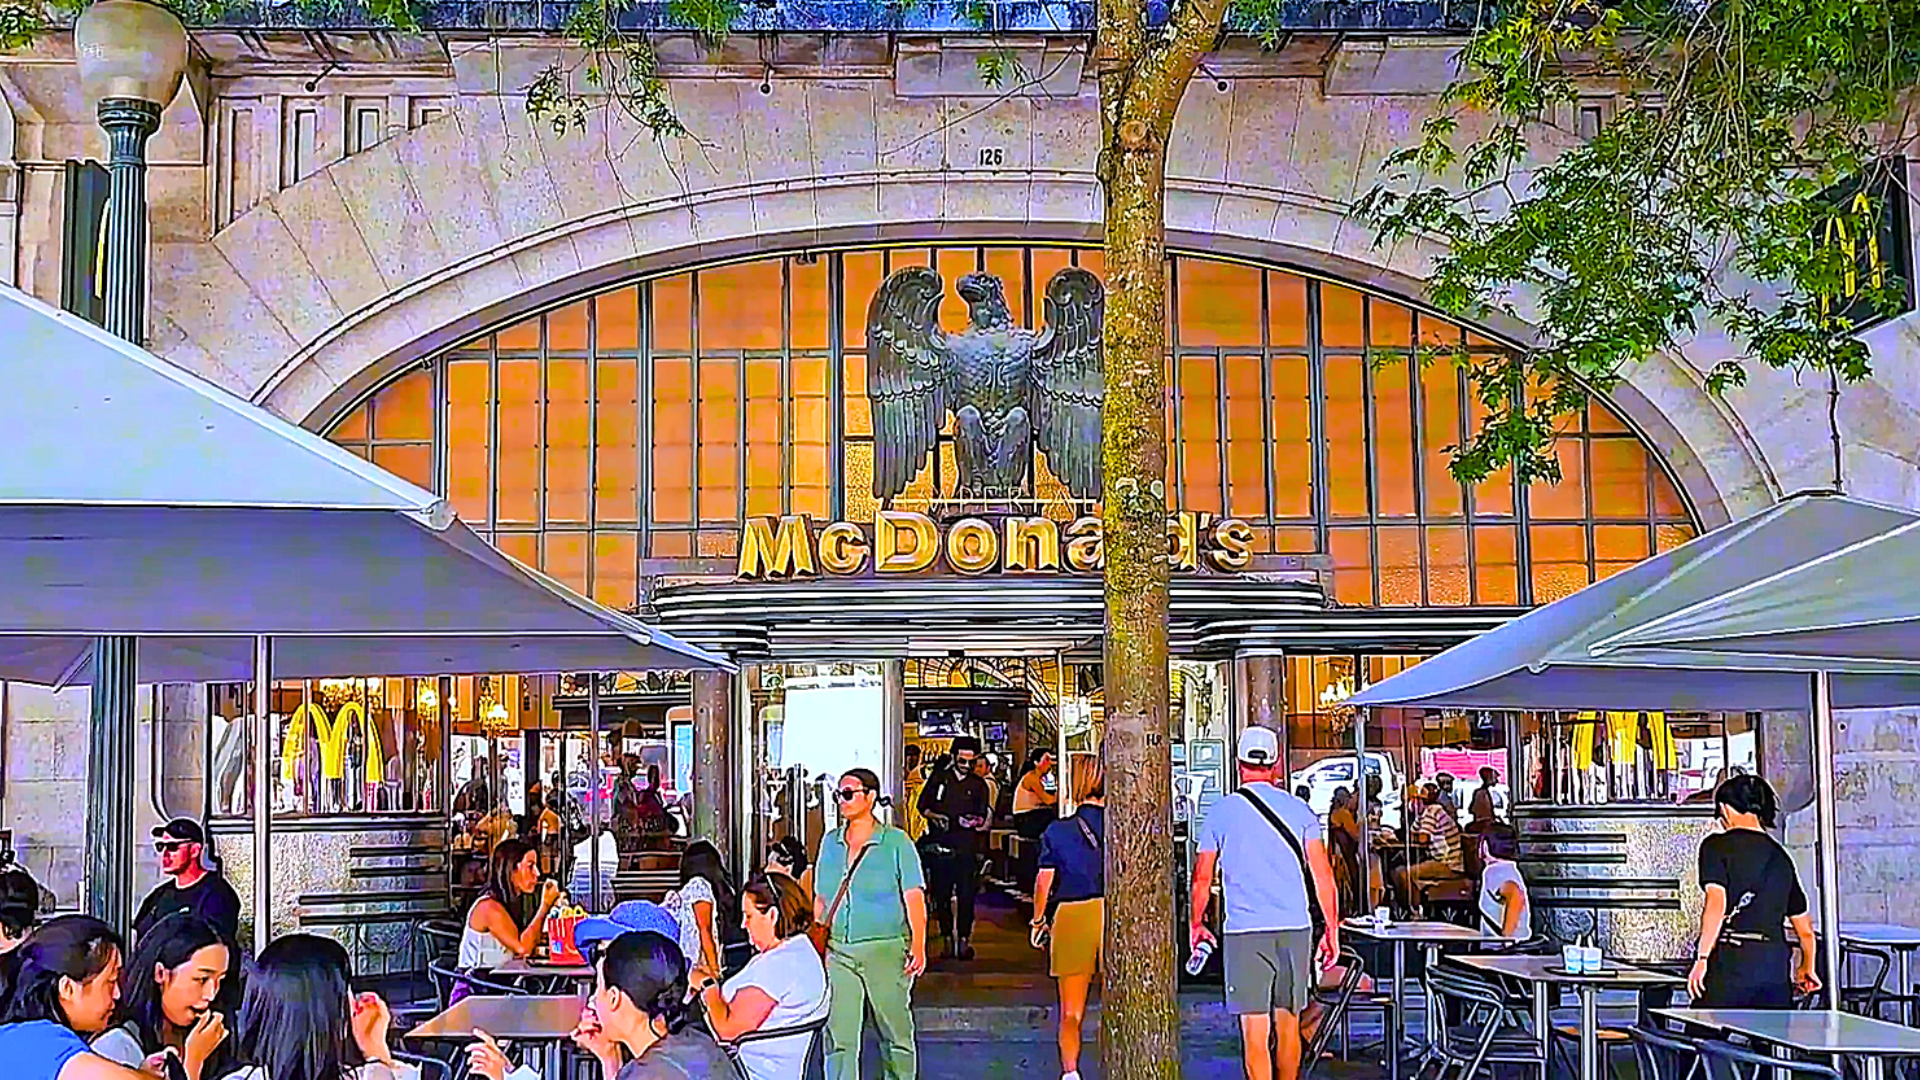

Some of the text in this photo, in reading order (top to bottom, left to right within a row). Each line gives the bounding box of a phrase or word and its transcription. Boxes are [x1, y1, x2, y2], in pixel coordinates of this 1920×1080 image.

[980, 149, 1002, 166] 126
[903, 485, 1097, 513] IMPERIAL
[737, 510, 1254, 578] McDonad's
